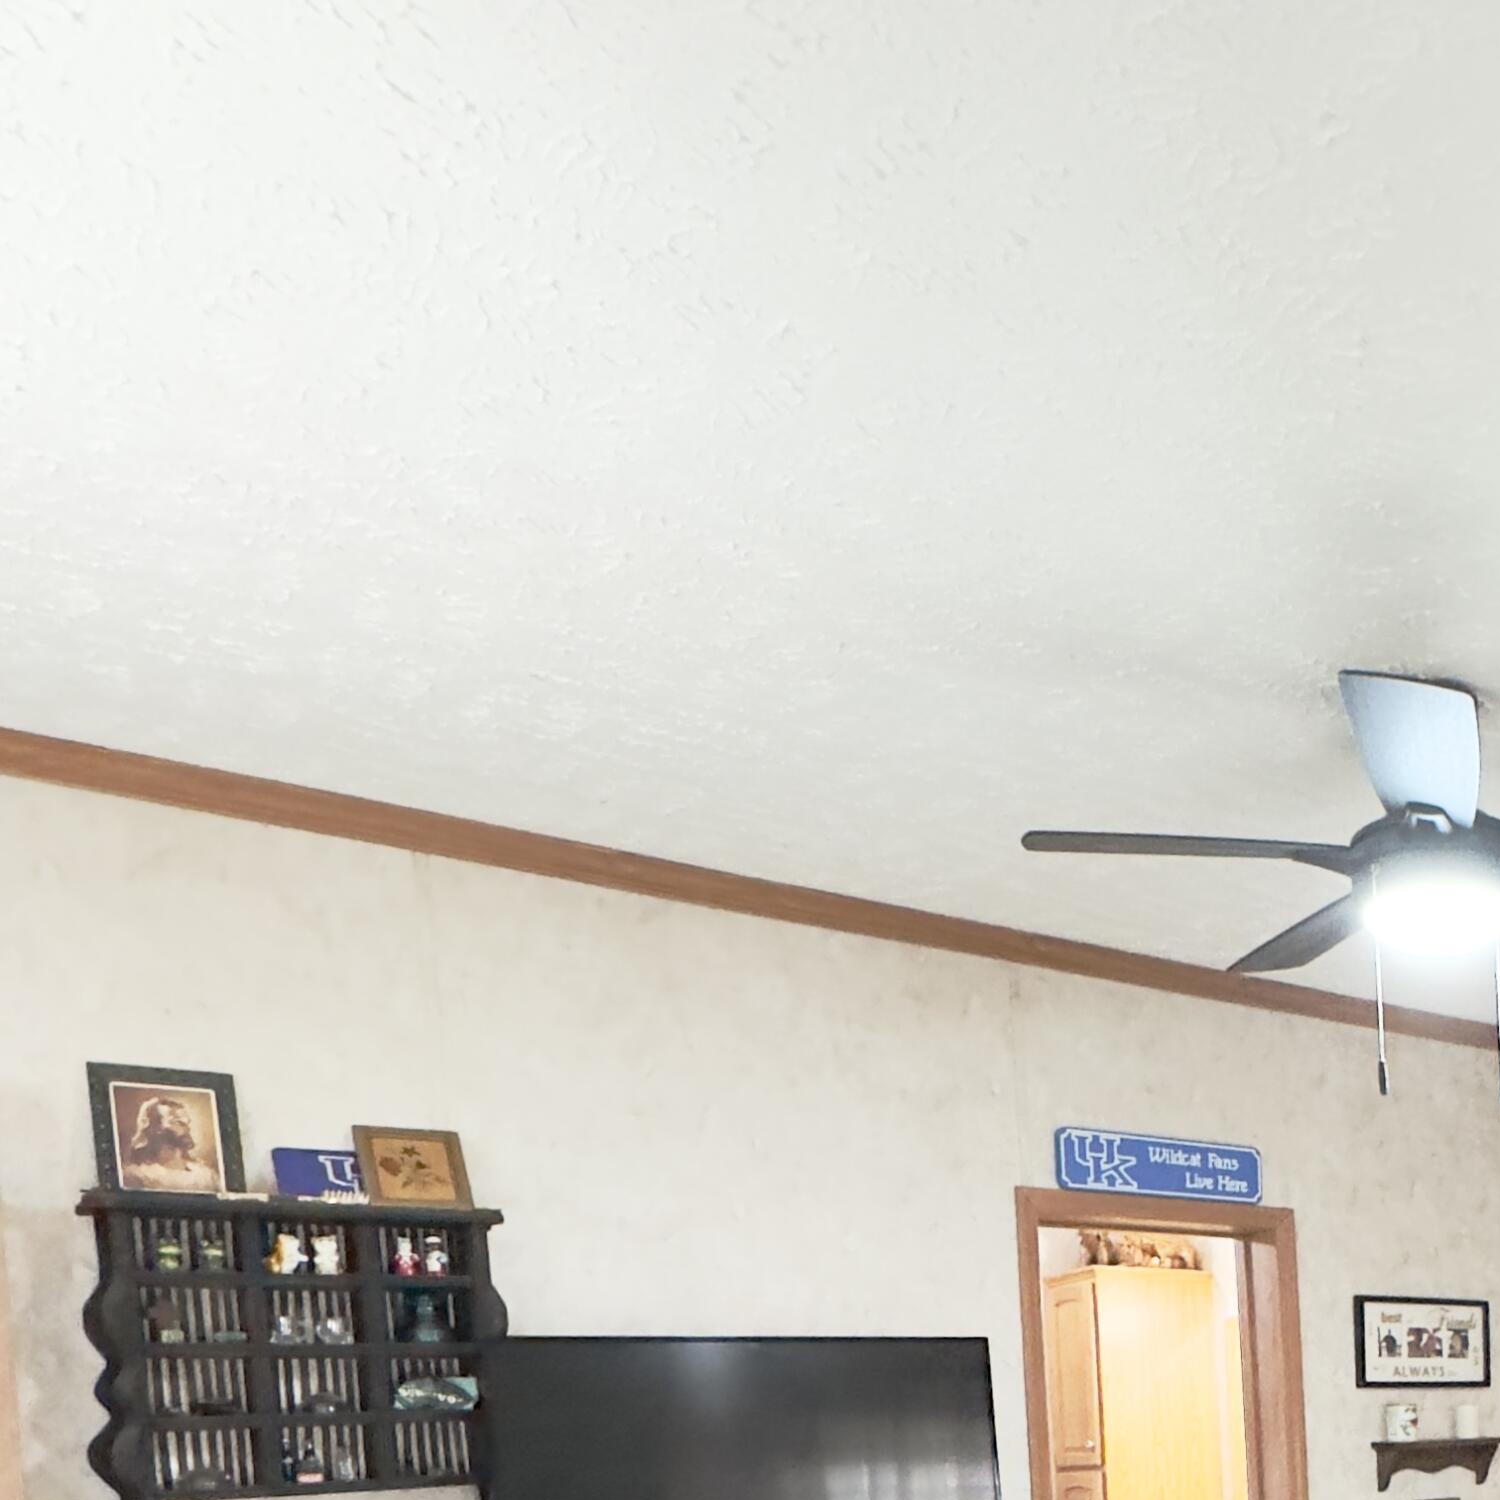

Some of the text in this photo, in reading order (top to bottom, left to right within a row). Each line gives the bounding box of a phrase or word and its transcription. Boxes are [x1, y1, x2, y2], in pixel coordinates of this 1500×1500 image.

[1070, 1133, 1138, 1190] UK
[1148, 1146, 1239, 1171] Wildcat Fans
[1185, 1172, 1248, 1193] Live Here
[1392, 1366, 1445, 1378] ALWAYS
